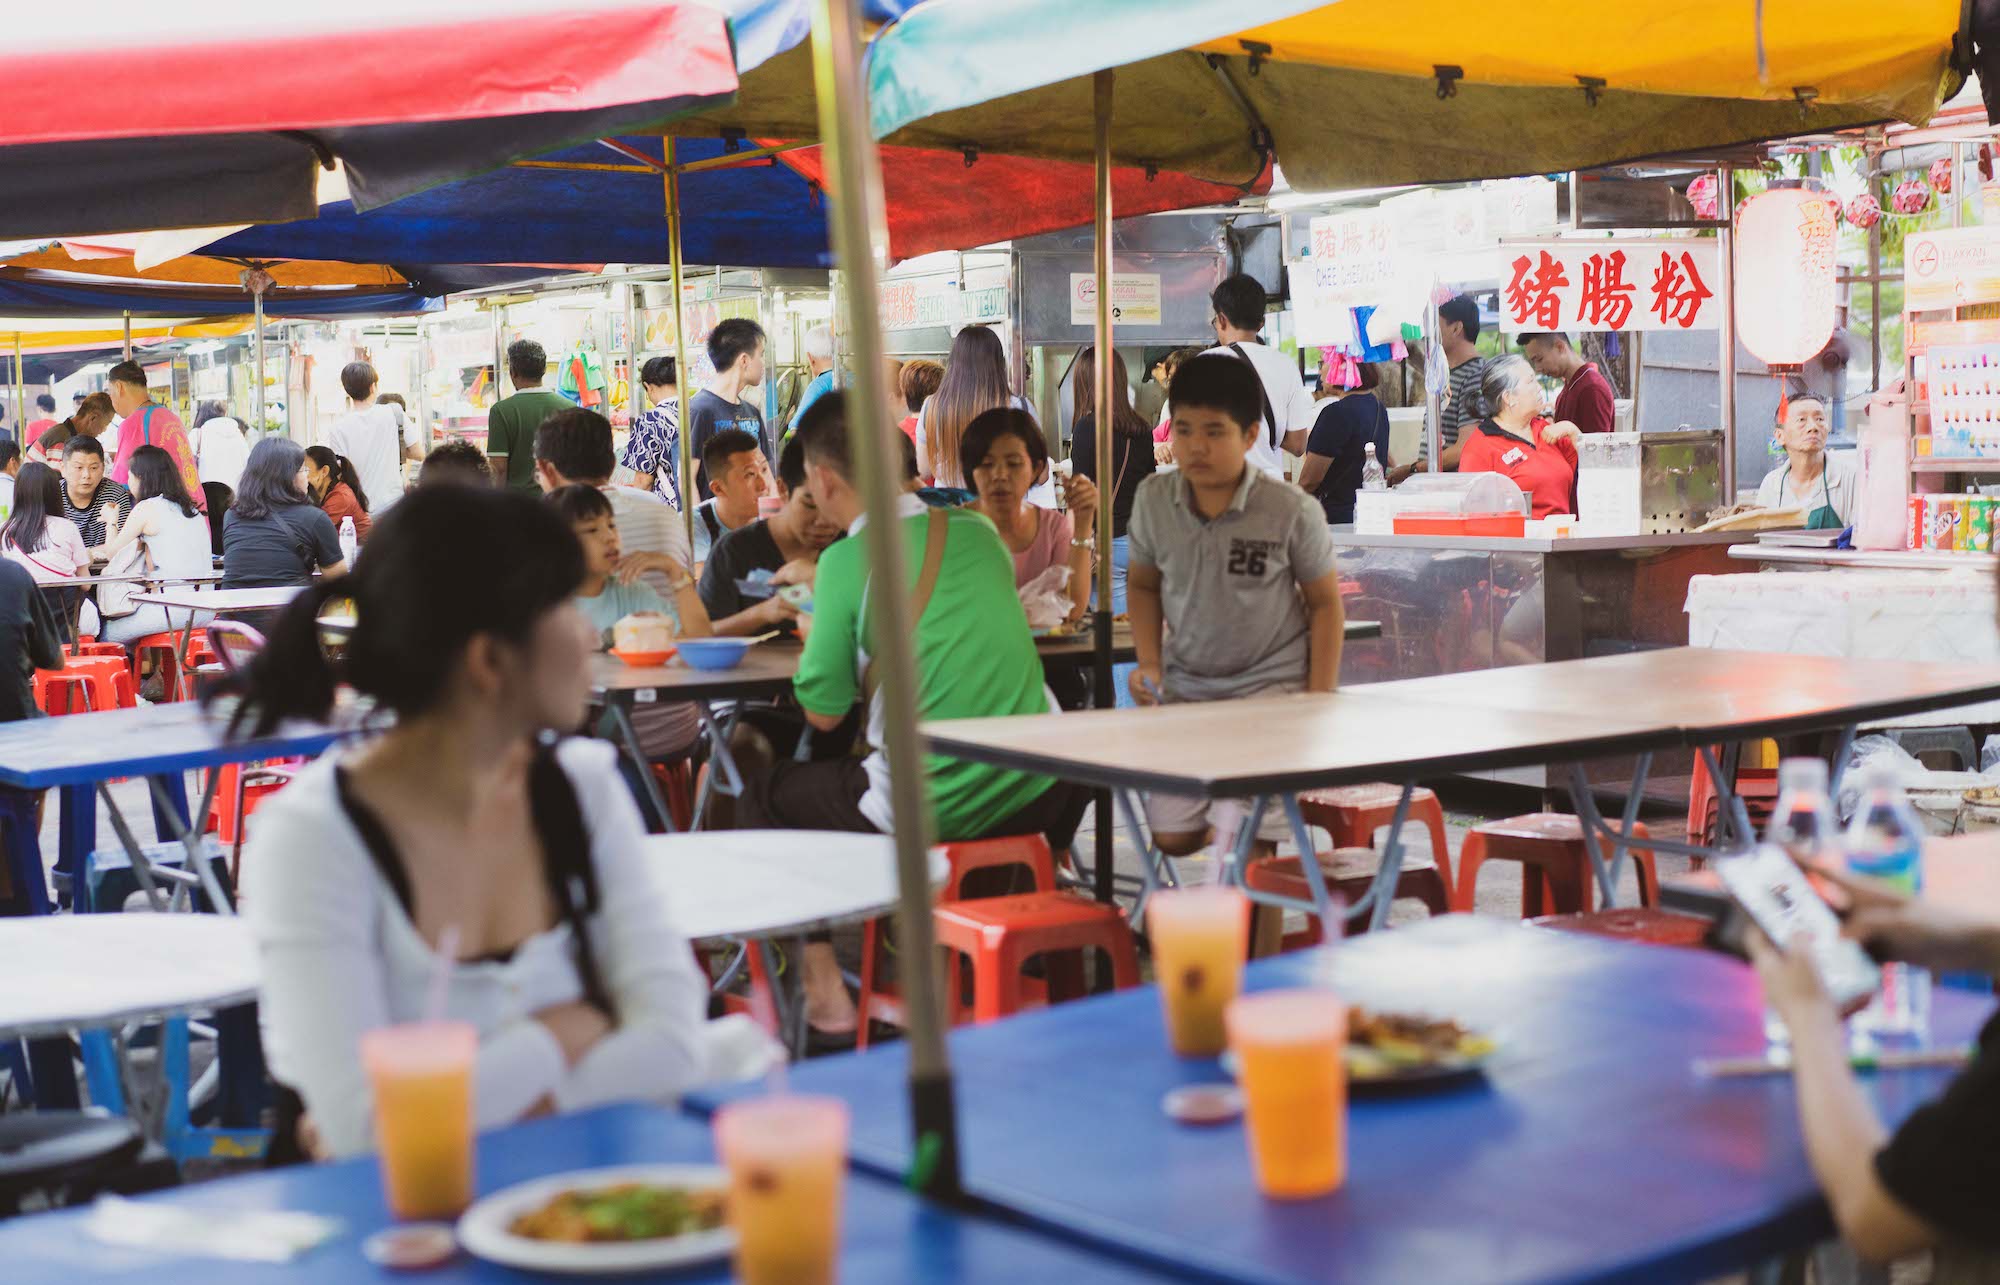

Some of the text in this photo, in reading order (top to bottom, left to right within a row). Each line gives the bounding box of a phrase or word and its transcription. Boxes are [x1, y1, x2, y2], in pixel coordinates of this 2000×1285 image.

[976, 287, 1006, 317] TEOW
[1504, 249, 1714, 331] 豬腸粉
[1228, 549, 1267, 576] 26
